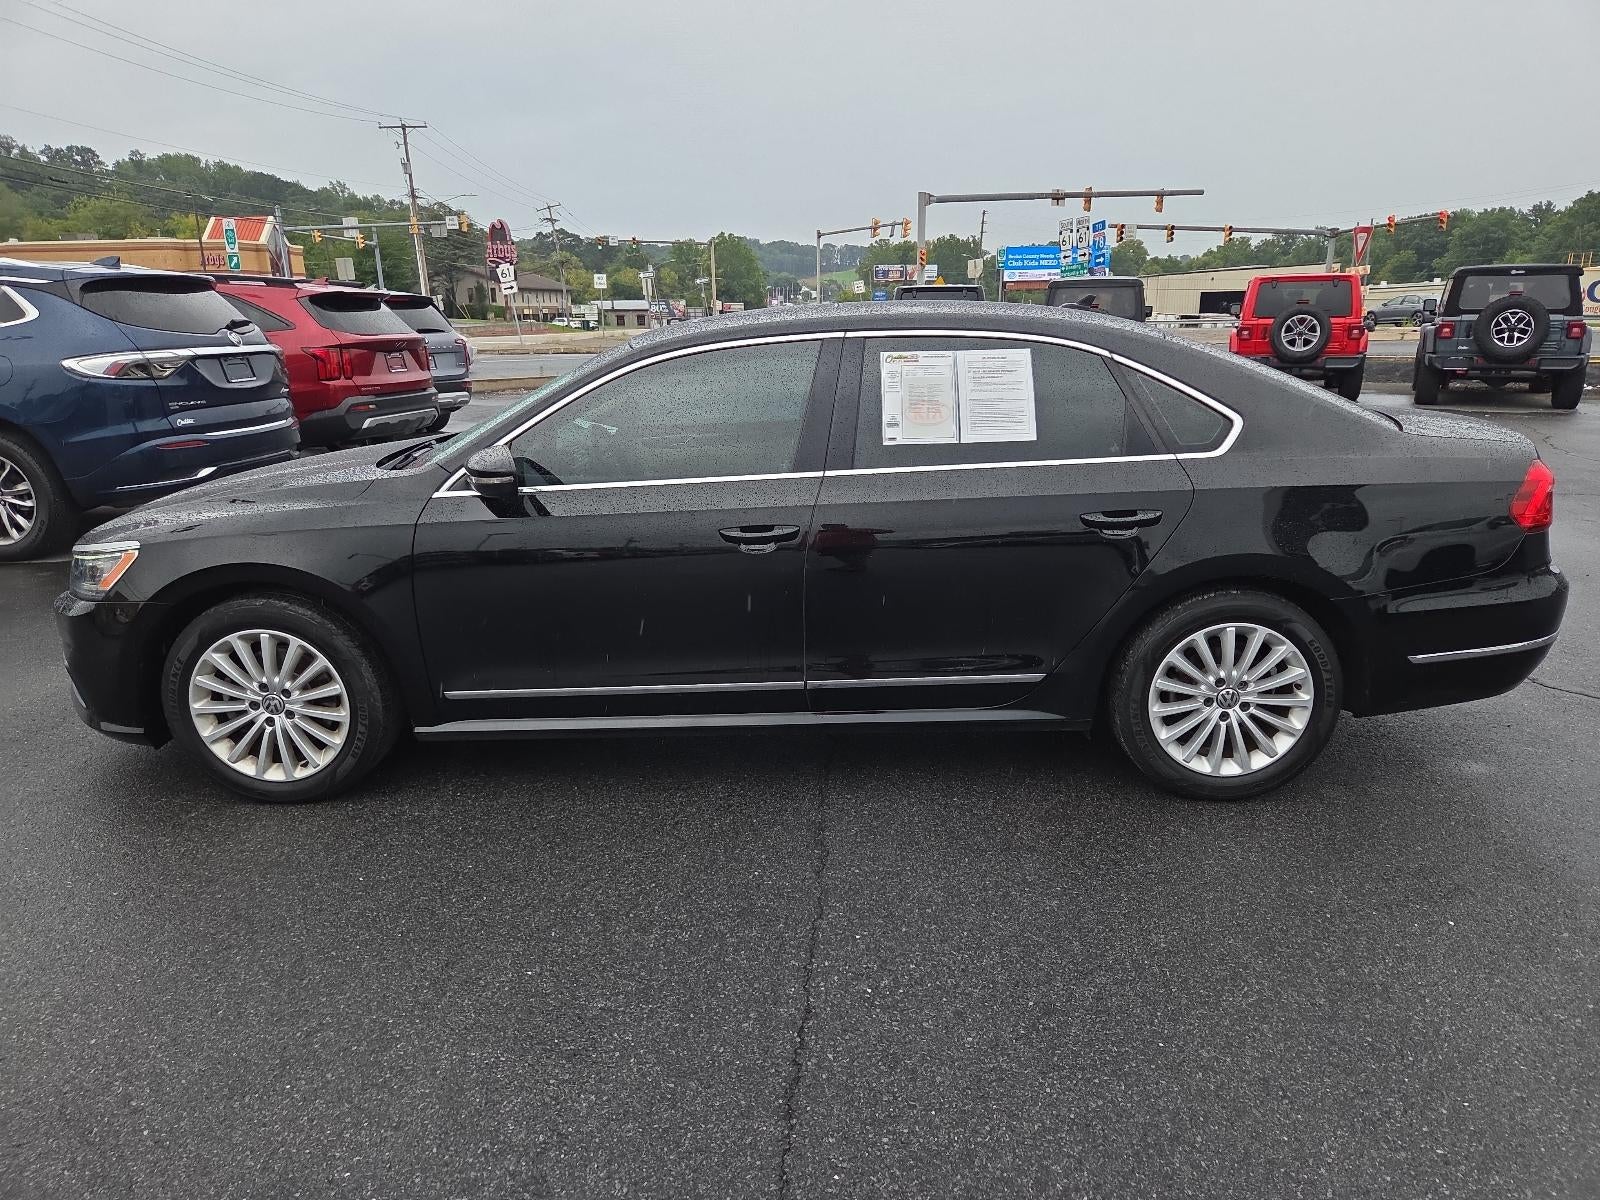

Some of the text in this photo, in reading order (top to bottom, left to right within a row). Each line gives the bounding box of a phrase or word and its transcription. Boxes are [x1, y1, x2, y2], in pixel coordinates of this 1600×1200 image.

[1062, 235, 1071, 246] 61
[1079, 232, 1087, 243] 61
[1095, 237, 1104, 250] 78
[501, 268, 511, 278] 61
